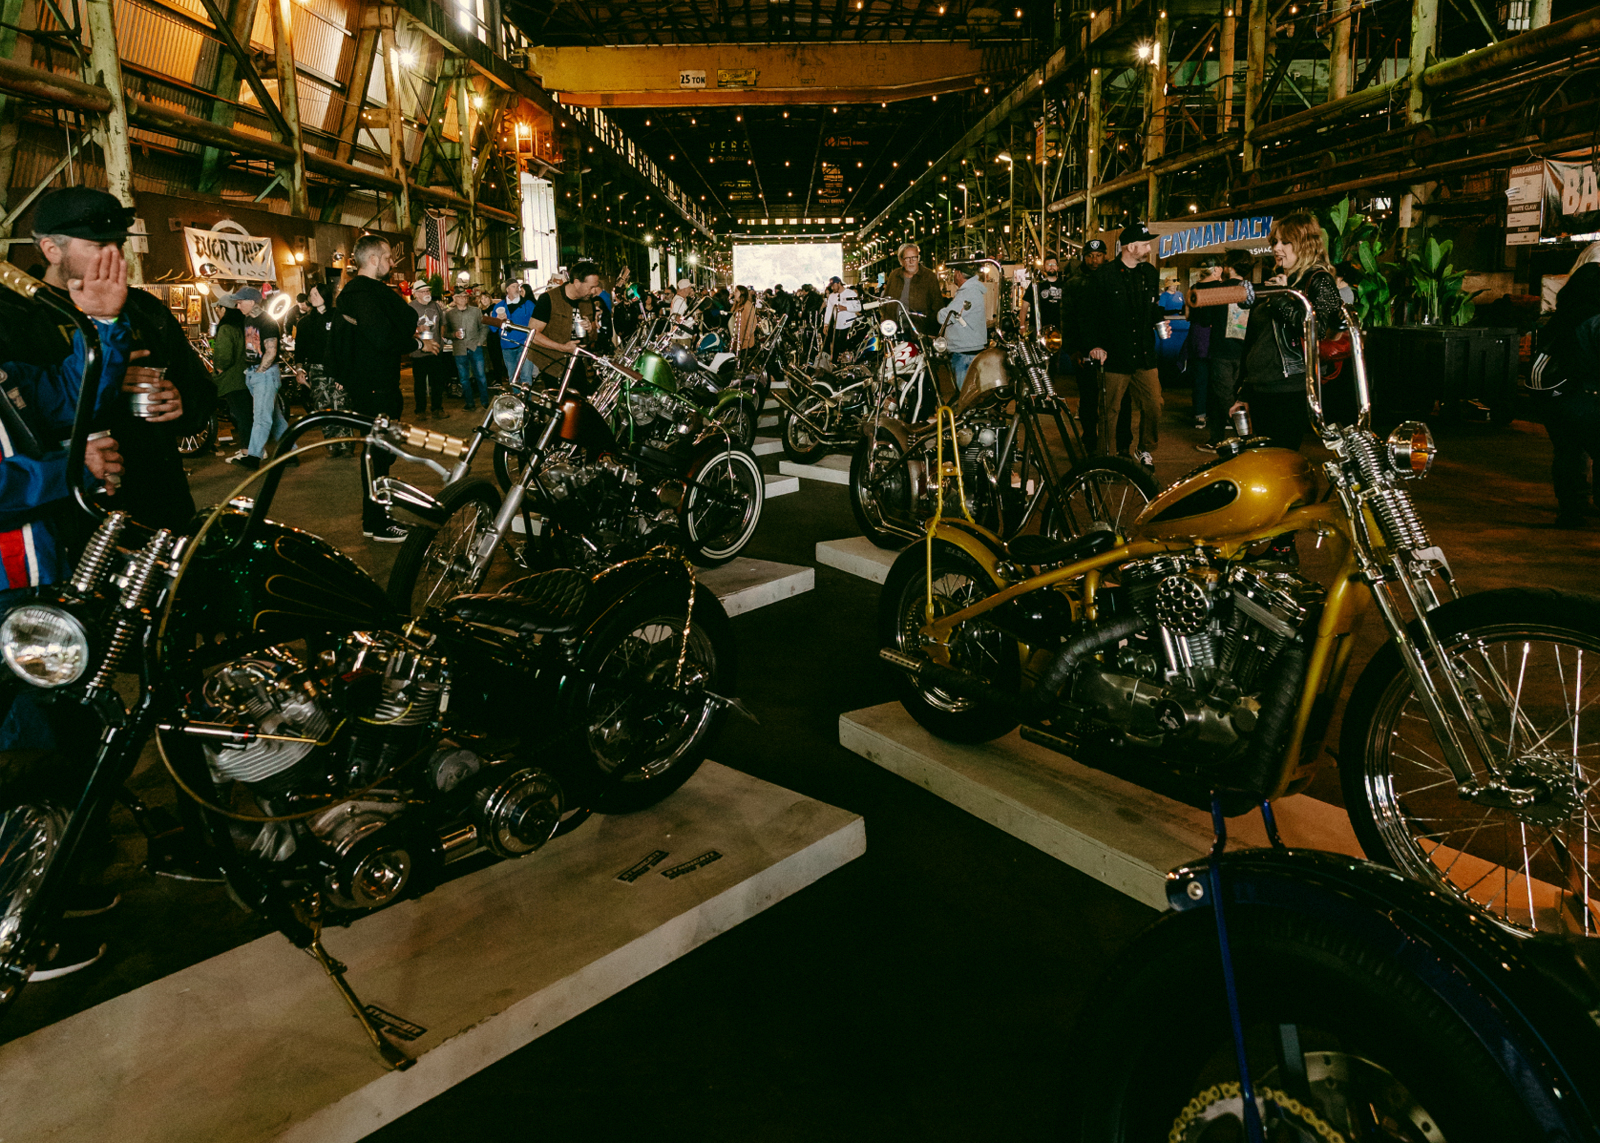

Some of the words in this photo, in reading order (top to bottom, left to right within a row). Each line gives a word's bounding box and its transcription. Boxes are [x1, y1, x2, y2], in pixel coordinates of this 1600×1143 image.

[680, 74, 690, 84] 25
[692, 76, 706, 84] TON
[1511, 164, 1542, 175] MARGARITAS
[1562, 165, 1600, 215] BA
[1159, 221, 1227, 259] CAYMAN
[1228, 216, 1274, 242] JACK
